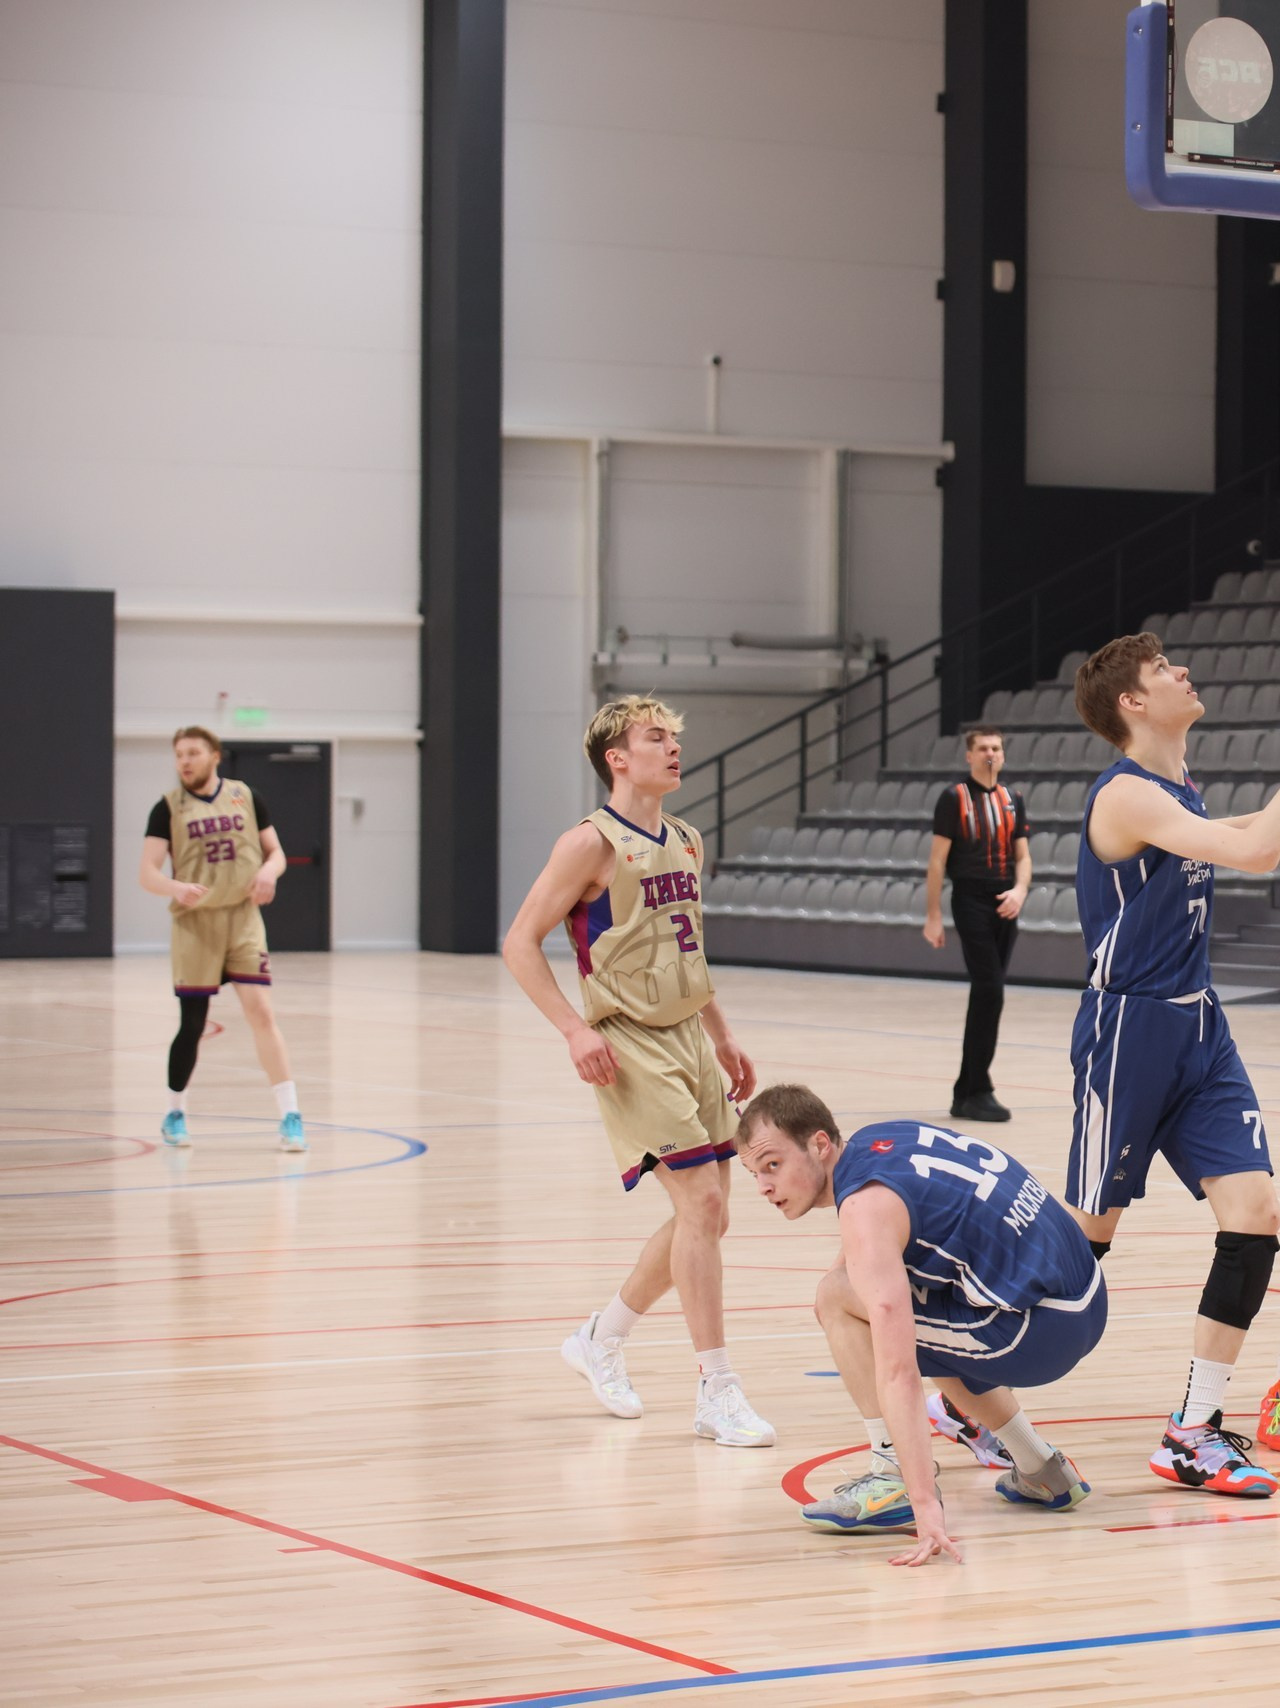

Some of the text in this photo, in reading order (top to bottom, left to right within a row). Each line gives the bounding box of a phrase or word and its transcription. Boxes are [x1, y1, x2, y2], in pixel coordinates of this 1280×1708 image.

[187, 814, 245, 839] ЦИВС
[206, 839, 236, 863] 23
[670, 913, 699, 953] 2
[1188, 896, 1208, 936] 7
[1242, 1110, 1262, 1150] 7
[909, 1126, 1009, 1202] 13
